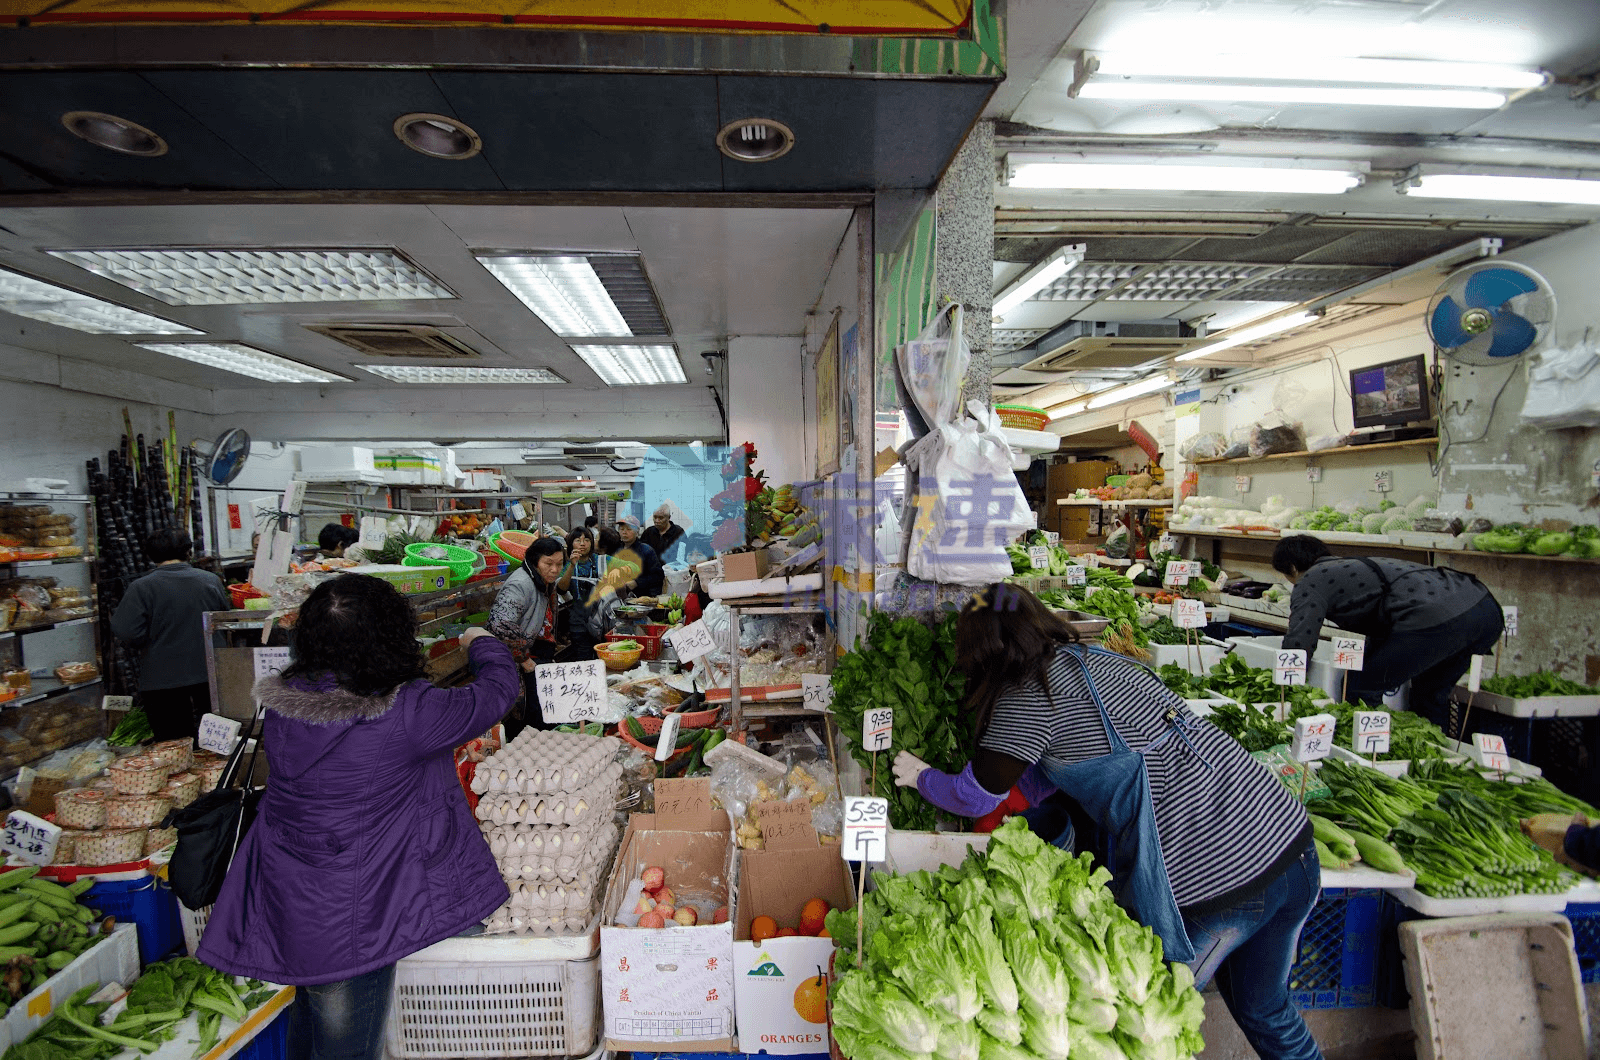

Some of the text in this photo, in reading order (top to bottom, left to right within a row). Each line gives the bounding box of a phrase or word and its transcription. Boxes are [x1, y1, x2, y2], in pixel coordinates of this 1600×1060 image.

[1035, 558, 1046, 568] 斤
[1170, 564, 1188, 573] 11元
[1072, 576, 1082, 585] 斤
[1174, 576, 1183, 585] 斤
[1338, 640, 1363, 651] 12元
[1278, 653, 1305, 667] 9元
[539, 664, 597, 681] 新鲜鸡蛋
[1283, 671, 1300, 685] 斤
[871, 711, 892, 731] 9.50
[1360, 715, 1388, 732] 9.50
[1304, 723, 1332, 738] 5元
[874, 733, 889, 750] 斤
[1366, 736, 1384, 752] 斤
[847, 801, 887, 823] 5.50
[855, 831, 879, 861] 斤
[760, 1034, 822, 1044] ORANGES
